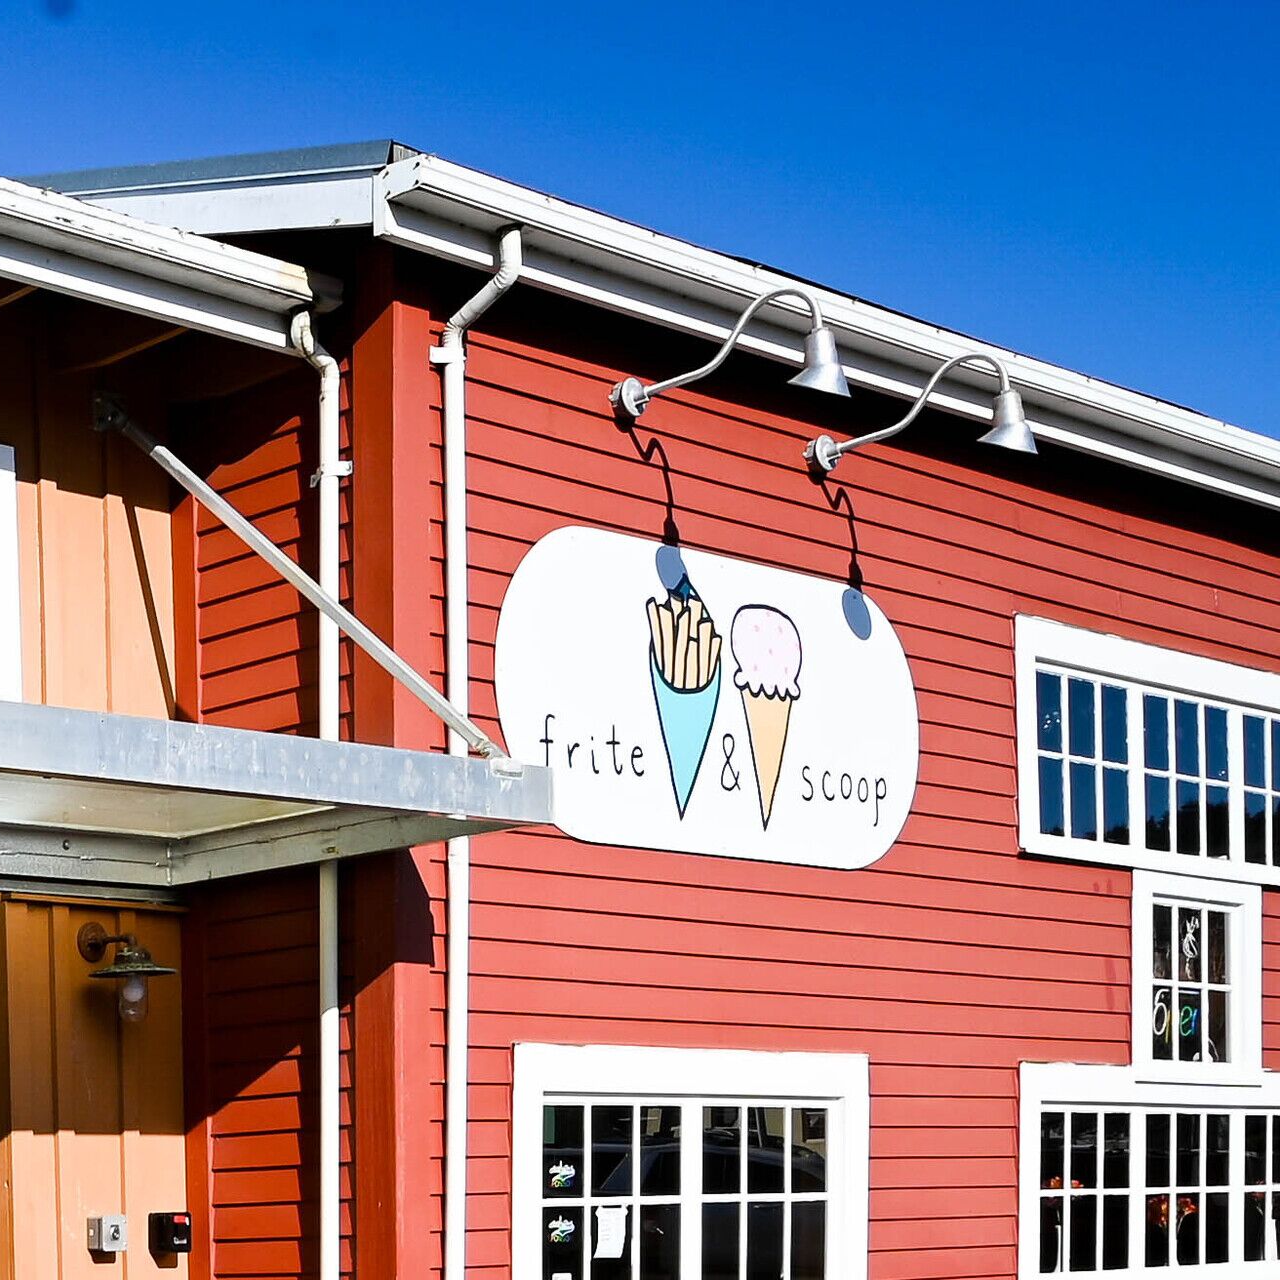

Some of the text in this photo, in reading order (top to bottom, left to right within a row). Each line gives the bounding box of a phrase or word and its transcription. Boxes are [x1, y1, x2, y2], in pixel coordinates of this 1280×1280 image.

[539, 713, 889, 827] frite & scoop
